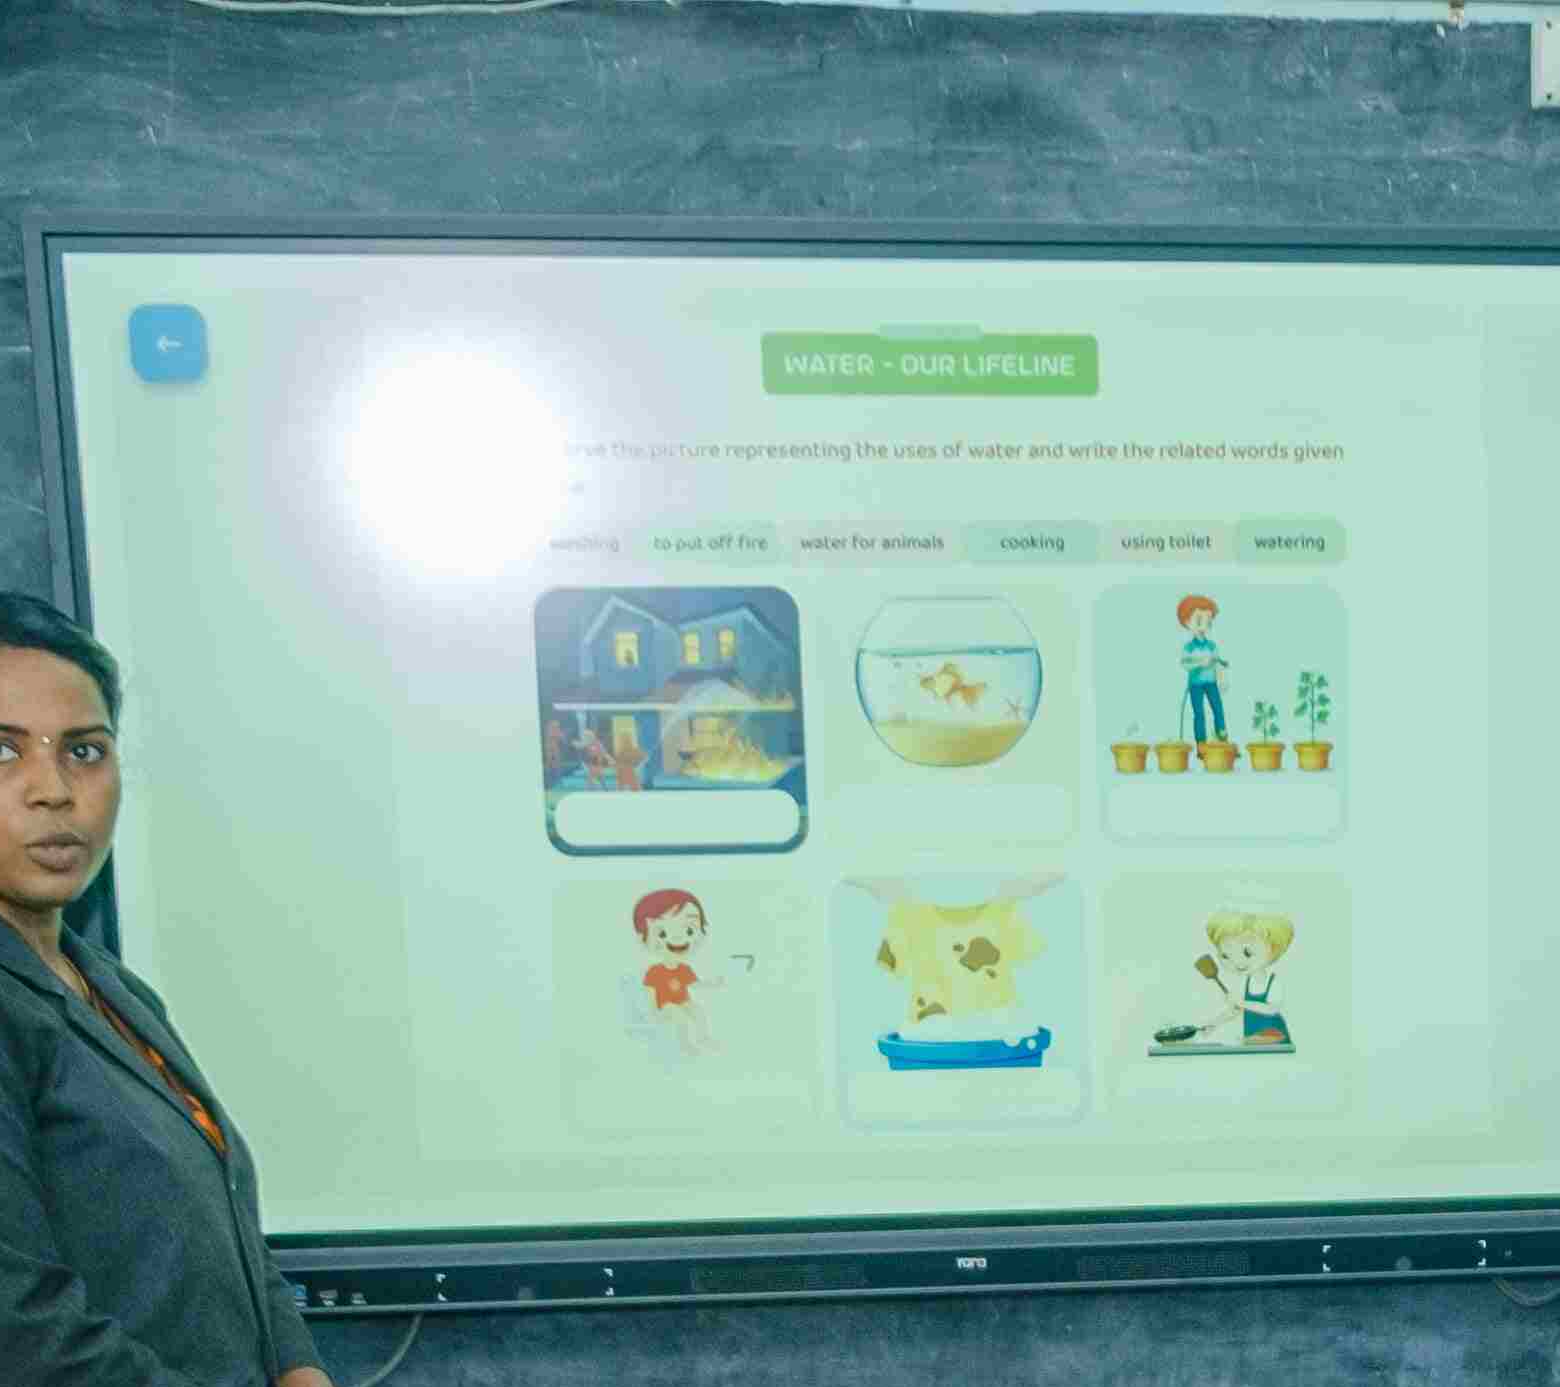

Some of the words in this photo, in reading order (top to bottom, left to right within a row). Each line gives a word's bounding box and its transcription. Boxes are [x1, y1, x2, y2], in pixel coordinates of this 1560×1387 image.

[784, 352, 874, 377] WATER
[901, 352, 955, 377] OUR
[963, 352, 1076, 377] LIFELINE
[612, 440, 643, 459] the
[650, 440, 721, 463] picture
[725, 440, 852, 464] representing
[857, 440, 889, 459] the
[894, 444, 938, 459] uses
[943, 440, 964, 459] of
[968, 443, 1023, 459] water
[1028, 440, 1064, 459] and
[1069, 440, 1118, 459] write
[1123, 440, 1154, 459] the
[1159, 440, 1226, 459] related
[1232, 440, 1289, 459] words
[1294, 442, 1345, 463] given
[654, 535, 672, 551] to
[675, 535, 703, 553] put
[707, 533, 734, 551] off
[737, 533, 768, 551] fire
[800, 535, 849, 550] water
[851, 533, 876, 550] for
[880, 533, 945, 551] animals
[999, 533, 1066, 554] cooking
[1121, 534, 1166, 554] using
[1169, 533, 1212, 551] toilet
[1254, 534, 1327, 554] watering
